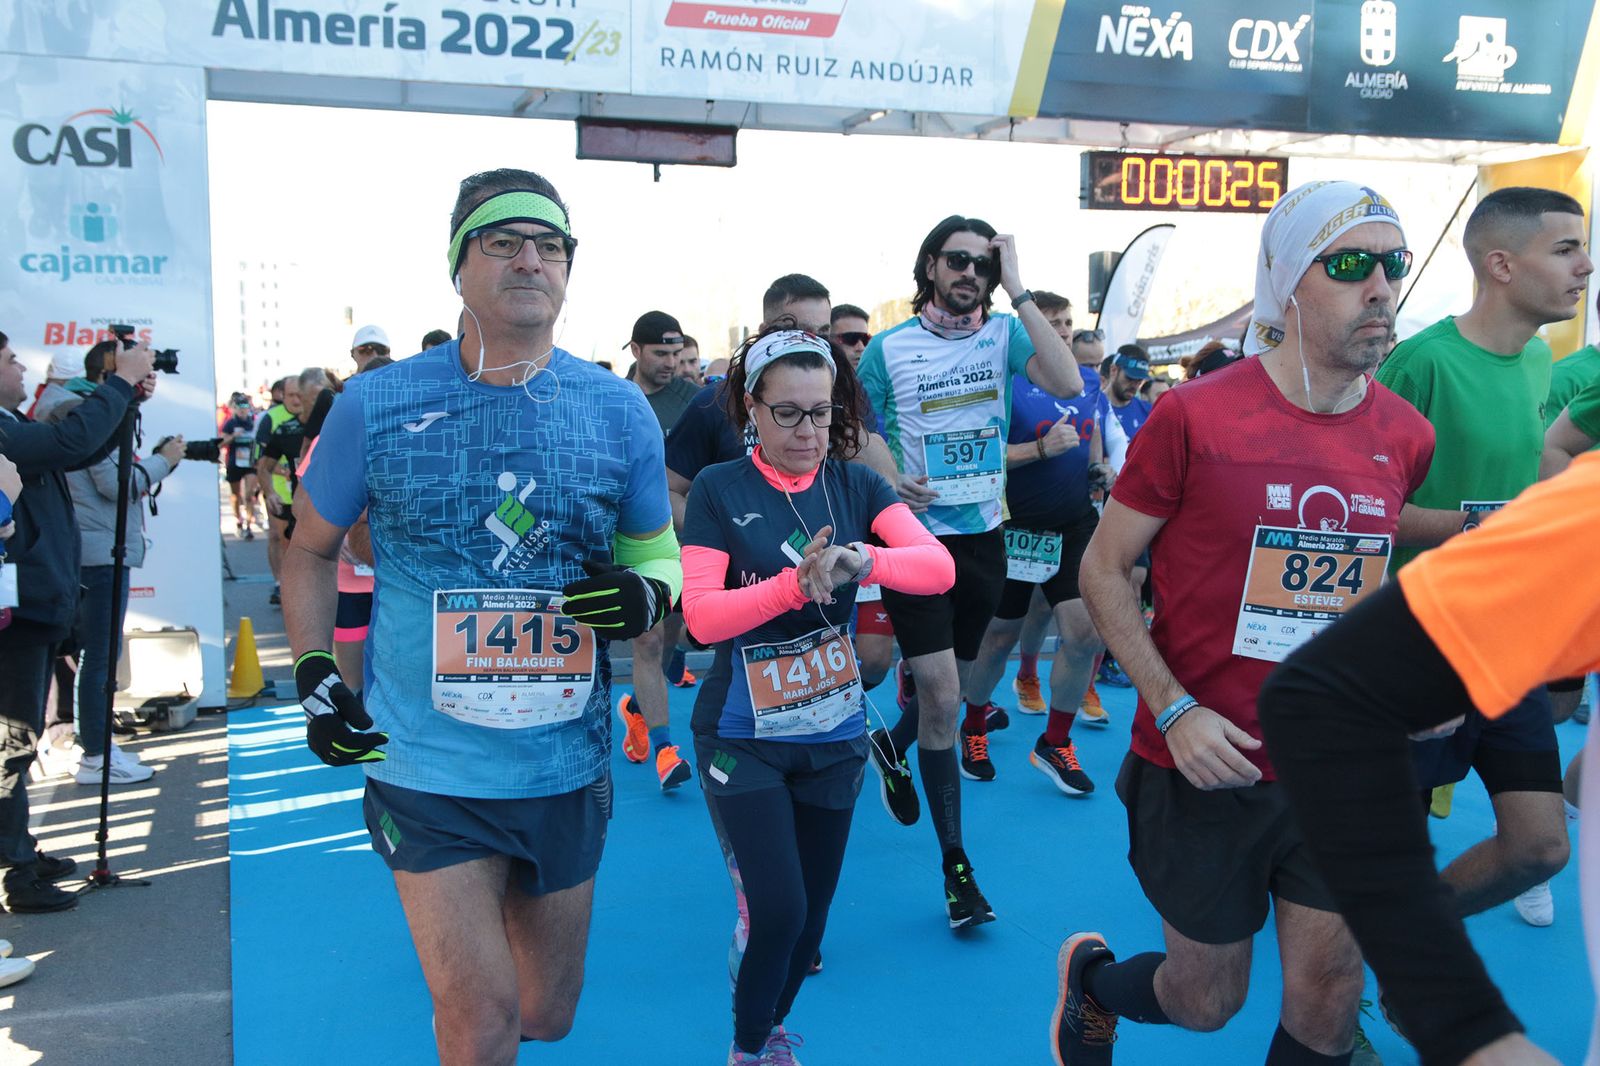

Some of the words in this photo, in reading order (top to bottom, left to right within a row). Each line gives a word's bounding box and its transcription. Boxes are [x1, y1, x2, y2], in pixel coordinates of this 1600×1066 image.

[703, 10, 757, 28] Prueba
[762, 14, 811, 32] Oficial
[1121, 4, 1151, 18] GRUPO
[212, 0, 426, 50] Almería
[1228, 14, 1311, 62] CDX
[660, 46, 763, 73] RAMÓN
[777, 54, 838, 78] RUIZ
[850, 59, 973, 87] ANDÚJAR
[1344, 70, 1409, 90] ALMERÍA
[13, 122, 133, 168] CASI
[1121, 157, 1280, 208] 00:00:25
[1369, 205, 1399, 219] ULTRA
[19, 245, 169, 282] cajamar
[44, 320, 153, 346] Blans
[950, 360, 993, 377] Maratón
[917, 377, 961, 394] Almería
[943, 440, 988, 465] 597
[502, 520, 549, 577] ATLETISMO
[1006, 532, 1055, 553] 1075
[1297, 541, 1326, 550] Almería
[1298, 534, 1319, 542] Medio
[519, 560, 530, 570] EL
[526, 536, 550, 560] EJIDO
[1280, 551, 1365, 596] 824
[482, 600, 515, 609] Almería
[455, 612, 582, 656] 1415
[466, 657, 492, 667] FINI
[496, 657, 565, 667] BALAGUER
[762, 641, 846, 692] 1416
